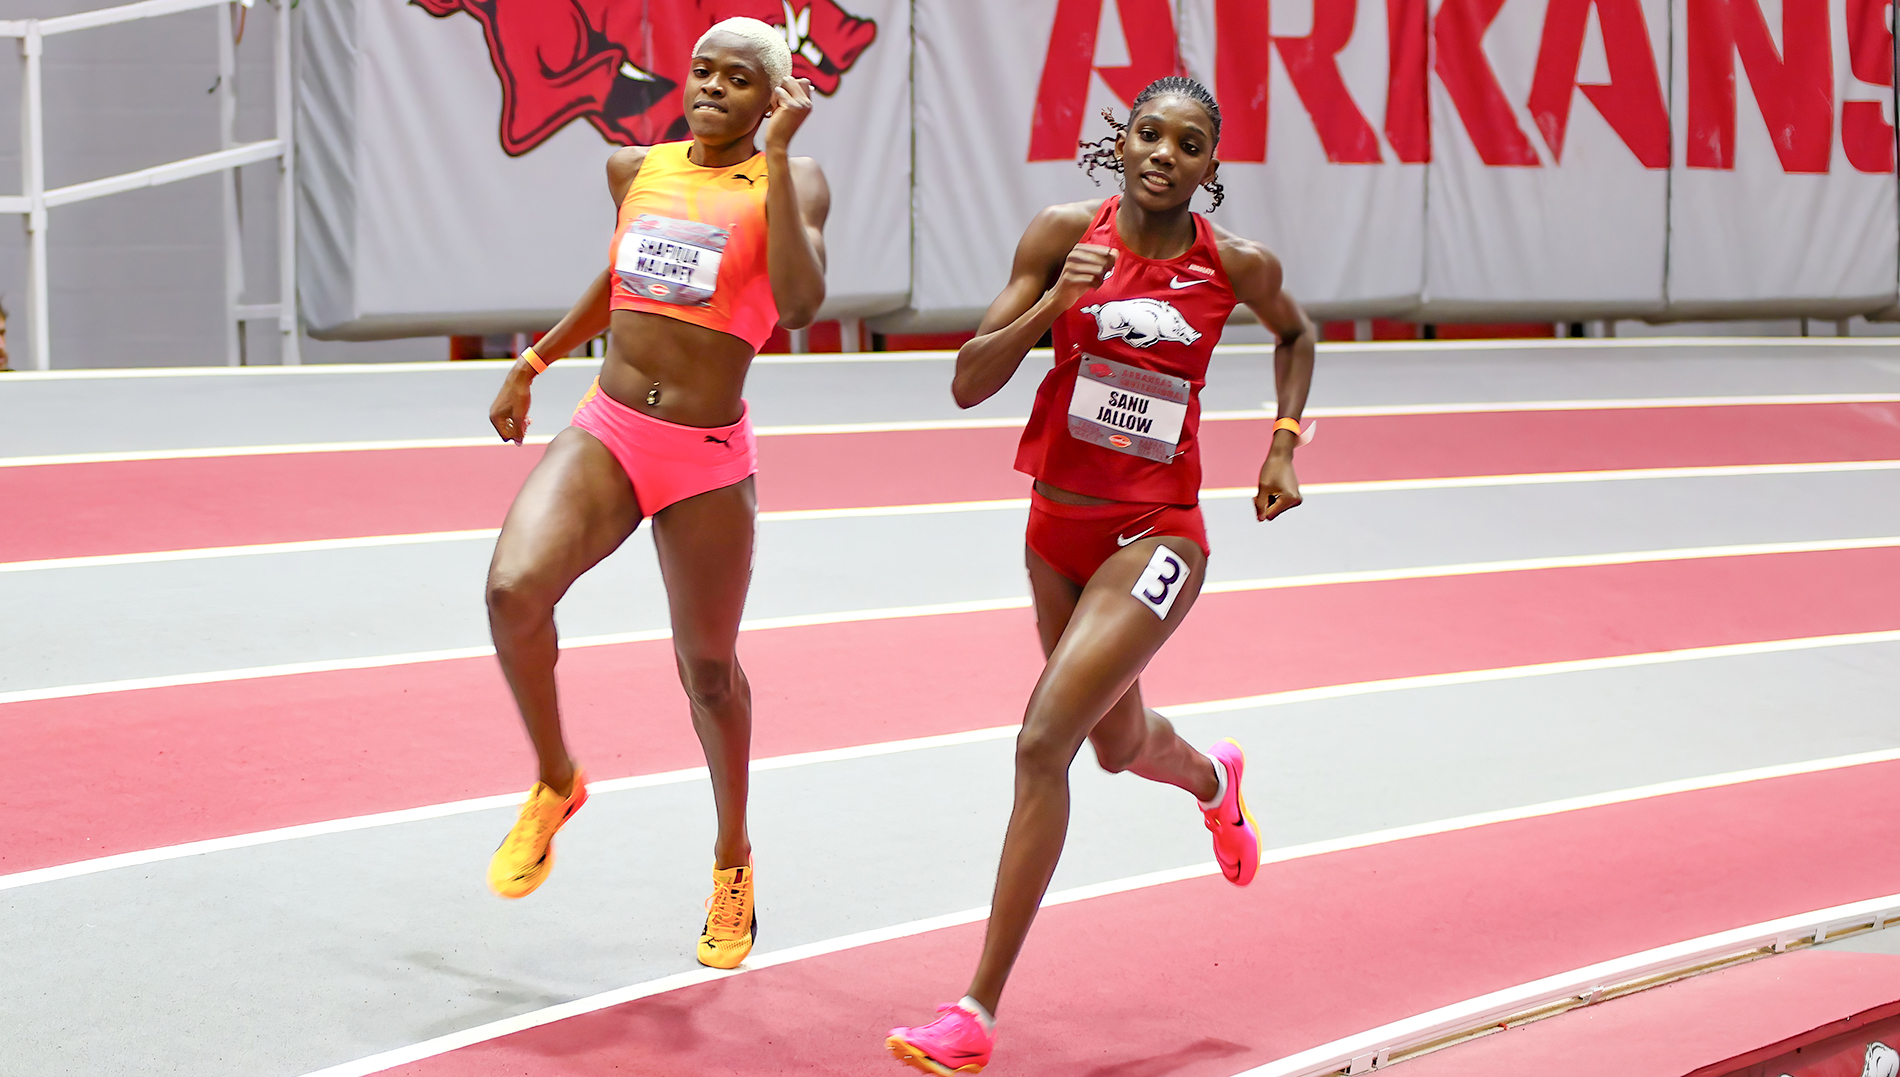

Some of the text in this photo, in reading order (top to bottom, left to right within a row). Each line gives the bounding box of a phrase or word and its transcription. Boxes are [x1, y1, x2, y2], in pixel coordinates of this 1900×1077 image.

[1108, 391, 1150, 415] SANU
[1096, 406, 1154, 434] JALLOW
[1142, 556, 1180, 605] 3
